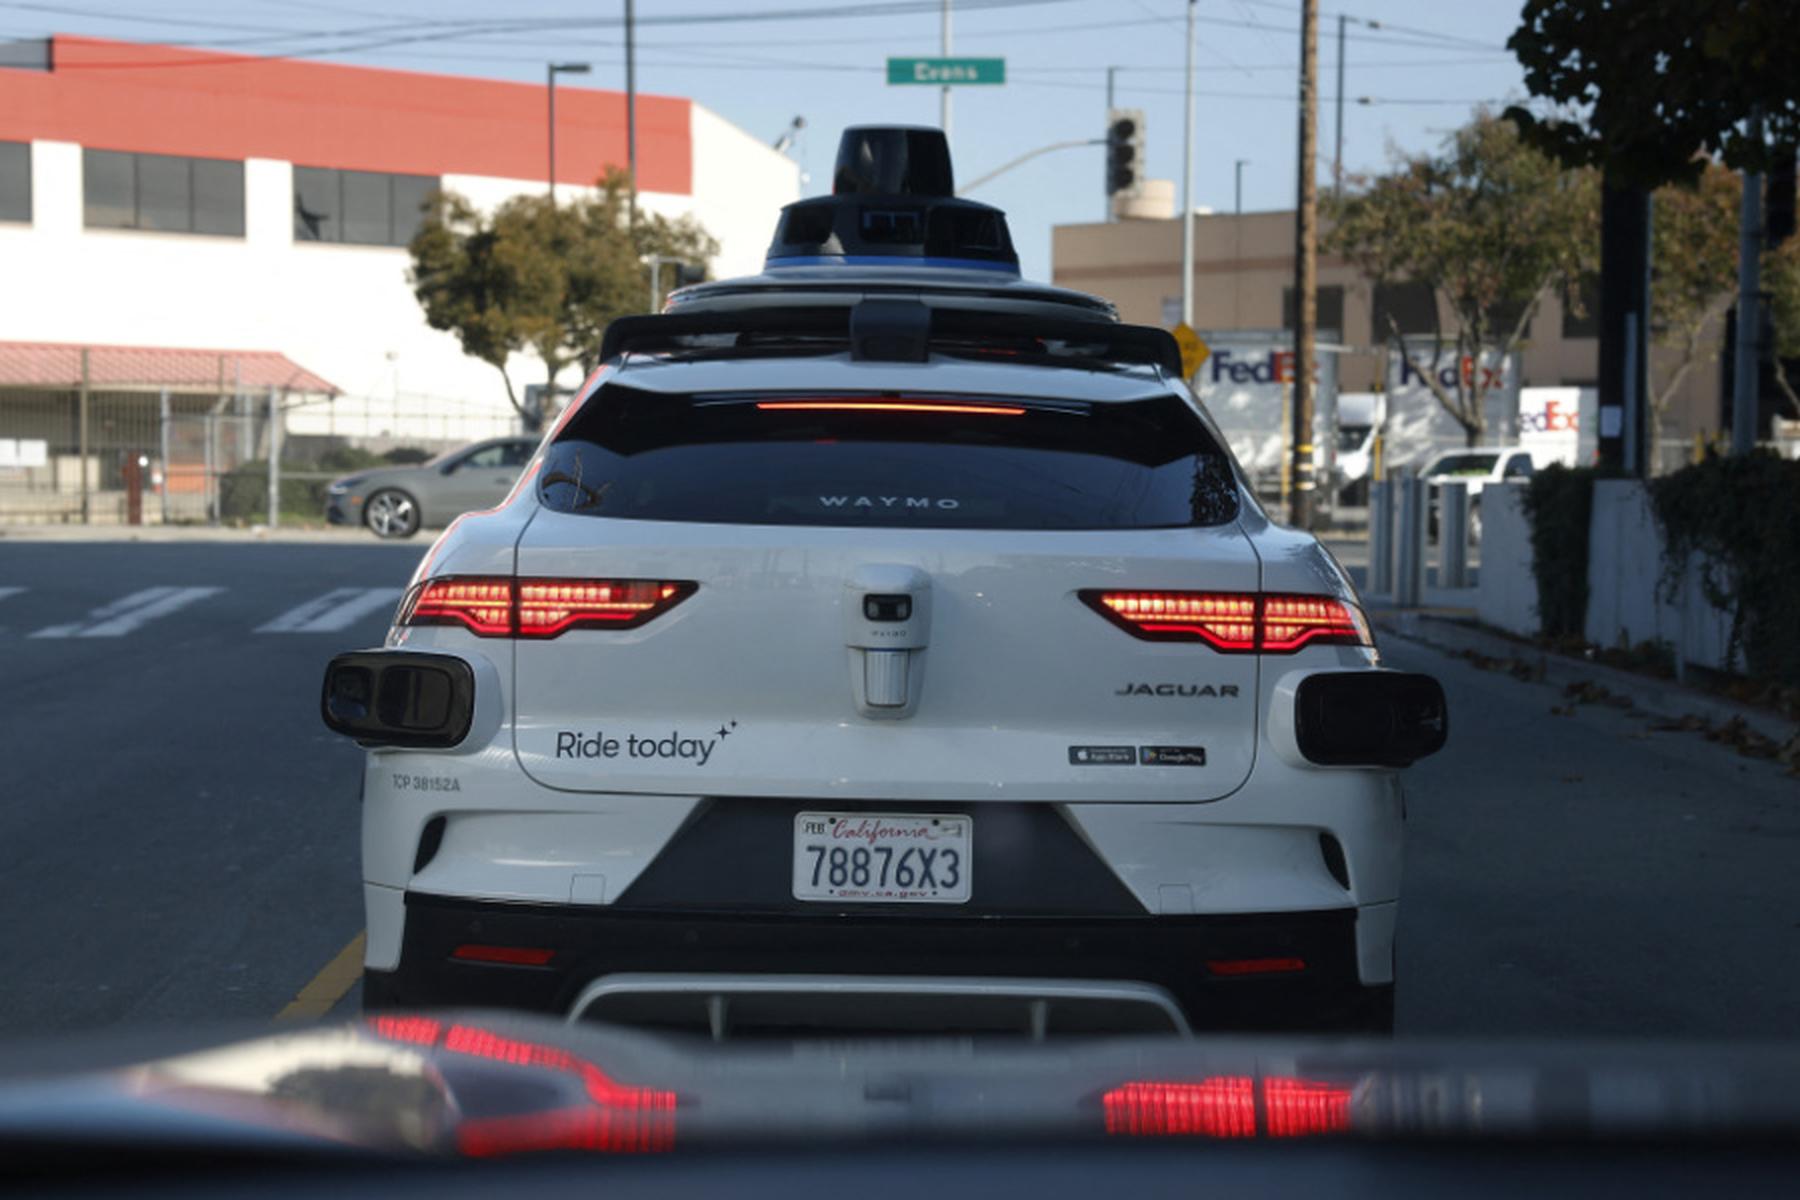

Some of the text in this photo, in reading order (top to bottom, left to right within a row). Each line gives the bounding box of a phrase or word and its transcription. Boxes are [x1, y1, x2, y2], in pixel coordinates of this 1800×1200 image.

[1212, 350, 1320, 384] FedE
[819, 496, 960, 509] WAYMO
[1115, 683, 1240, 698] JAGUAR
[555, 731, 716, 766] Ride today
[805, 821, 825, 834] FEB
[831, 819, 938, 844] California
[806, 845, 960, 889] 78876X3
